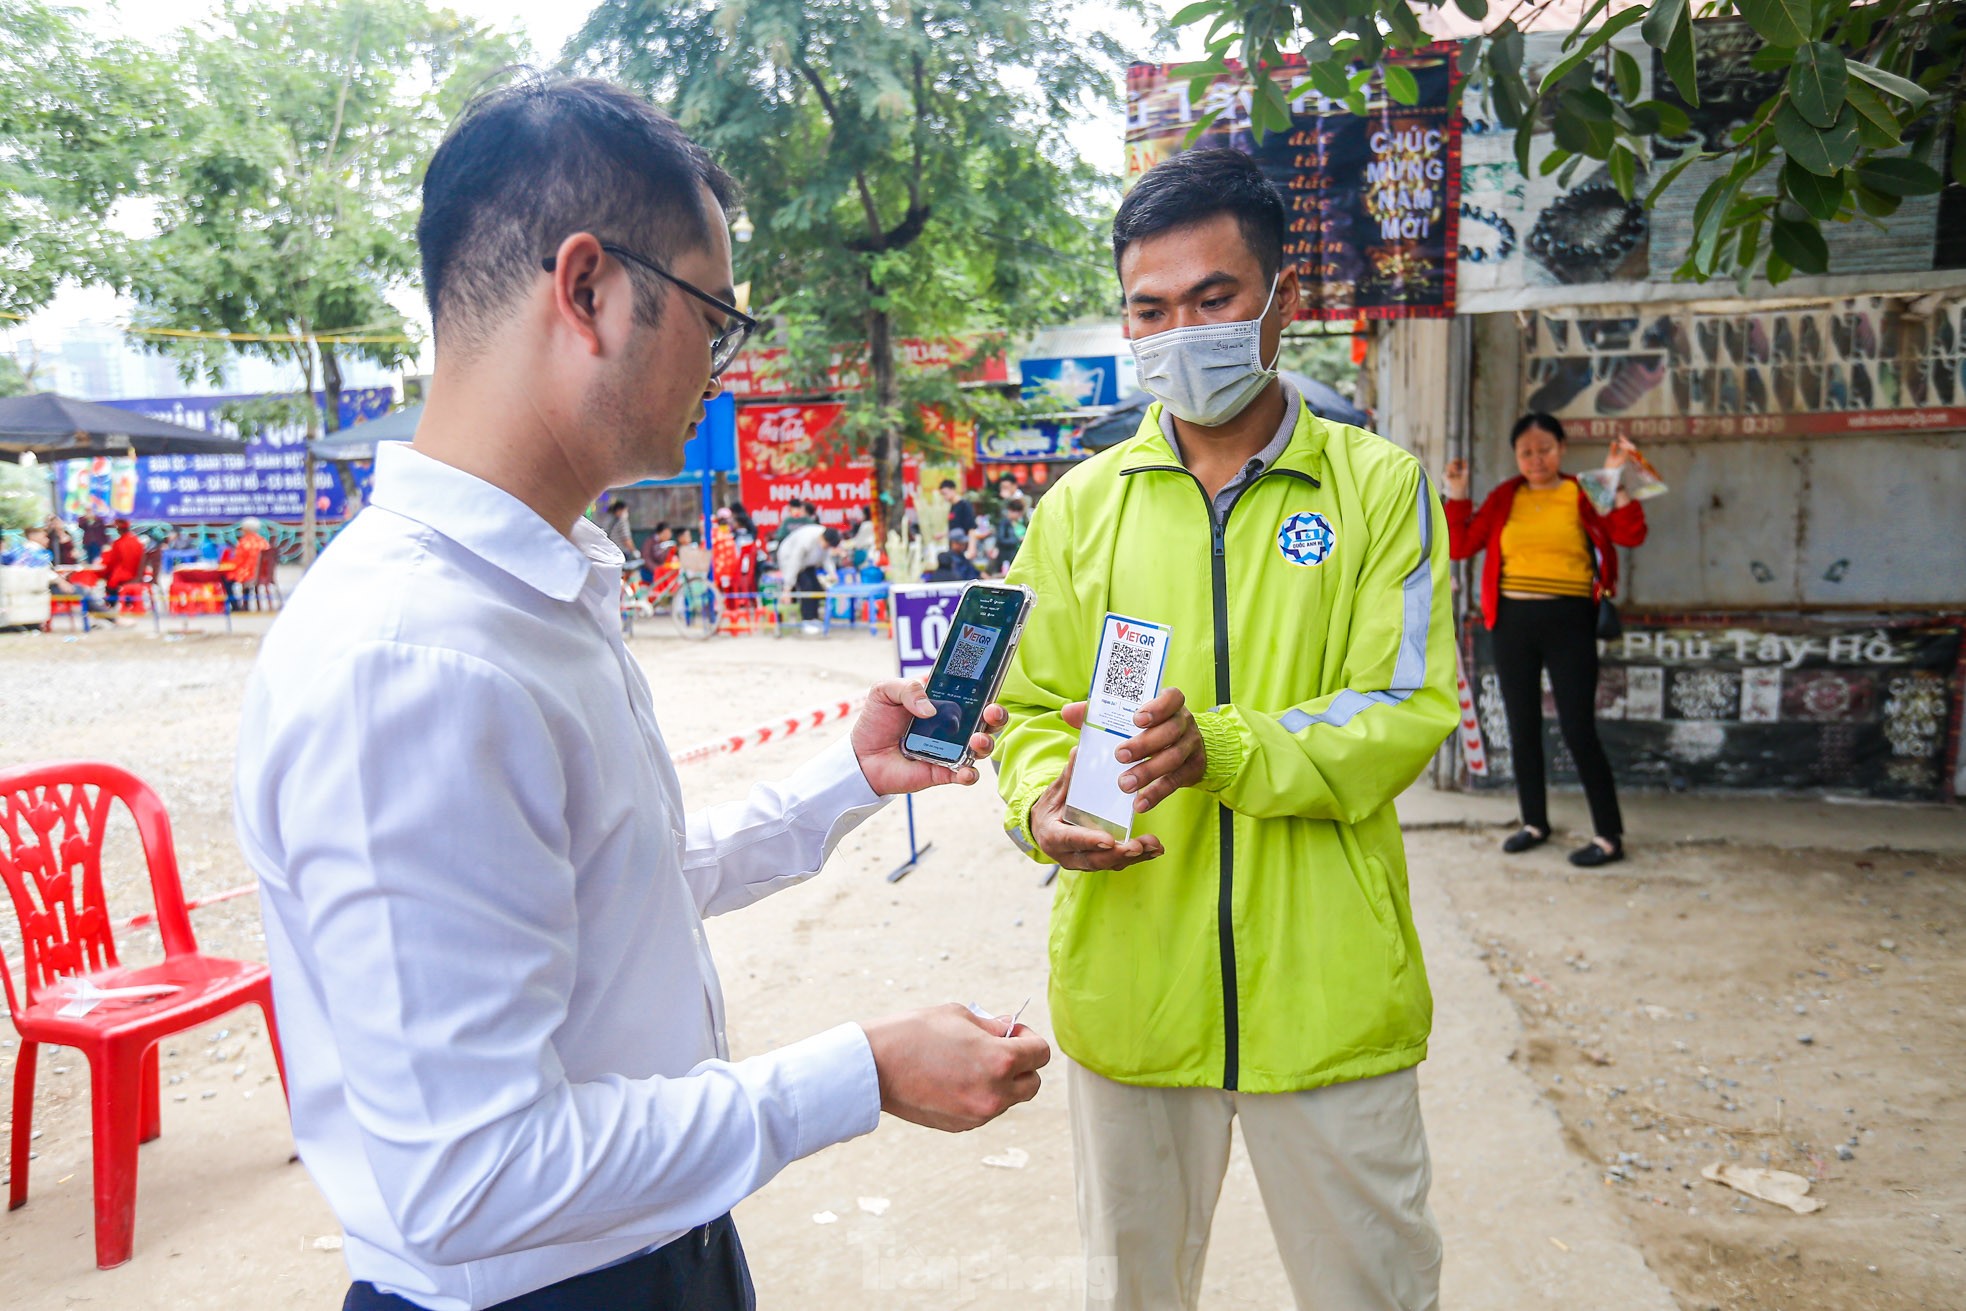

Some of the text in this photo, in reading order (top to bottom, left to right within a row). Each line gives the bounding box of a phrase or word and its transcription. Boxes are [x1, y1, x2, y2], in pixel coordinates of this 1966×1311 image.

[1370, 125, 1442, 153] CHÚC
[1366, 158, 1444, 183] MỪNG
[963, 625, 992, 646] VIETQR
[1115, 621, 1156, 648] VIETQR
